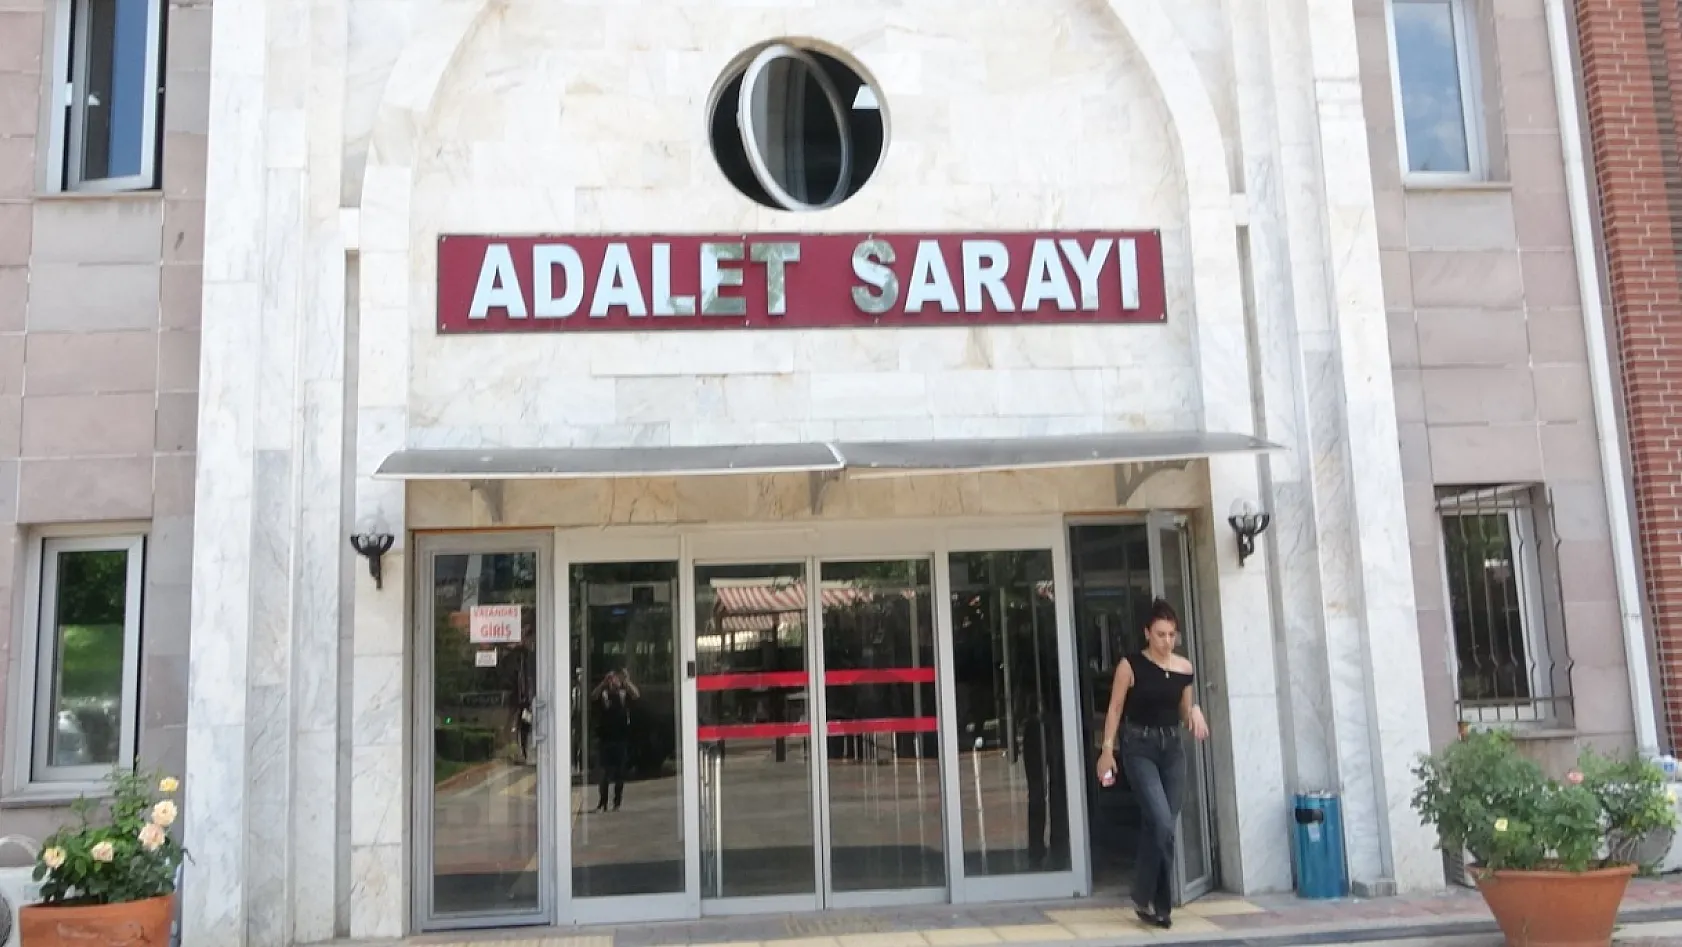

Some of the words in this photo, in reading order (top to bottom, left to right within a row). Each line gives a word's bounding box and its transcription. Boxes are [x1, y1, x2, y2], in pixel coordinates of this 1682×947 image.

[467, 241, 801, 320] ADALET
[850, 237, 1140, 315] SARAYI
[479, 621, 513, 640] GİRİŞ
